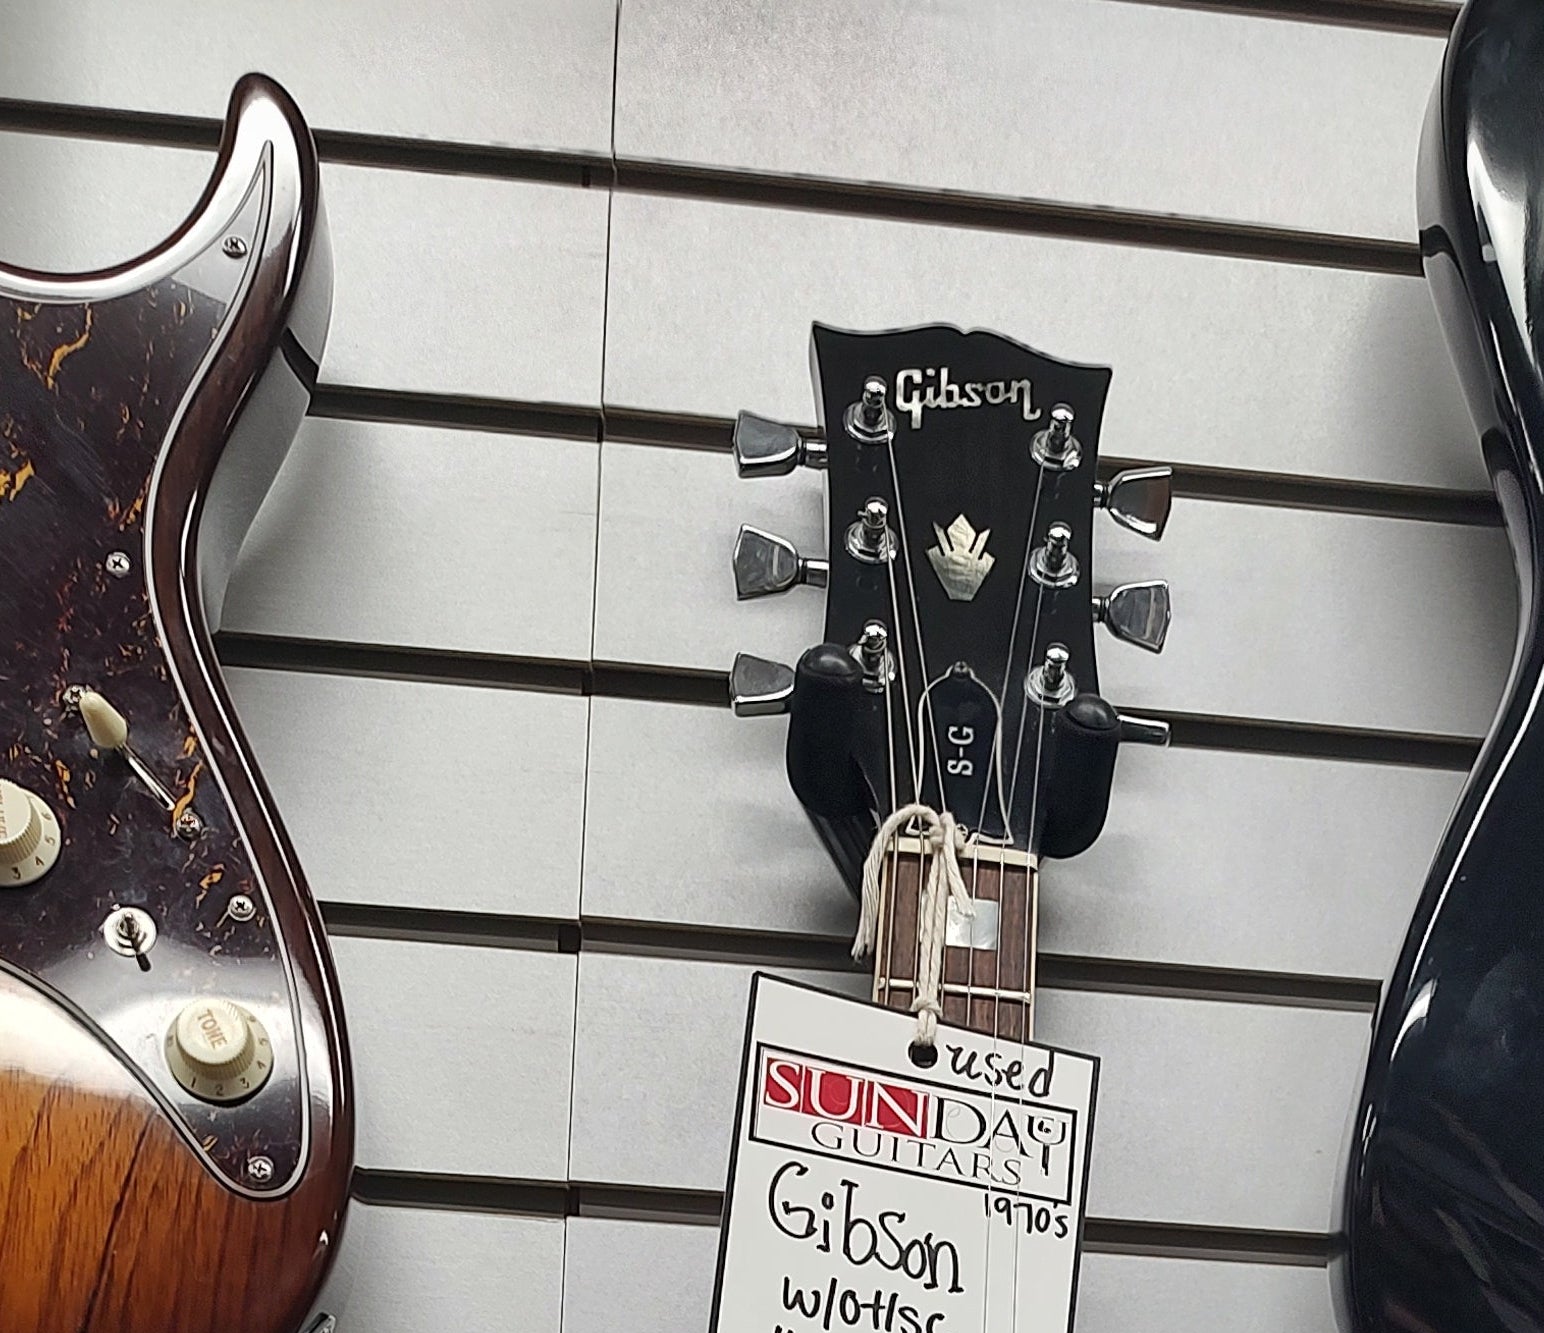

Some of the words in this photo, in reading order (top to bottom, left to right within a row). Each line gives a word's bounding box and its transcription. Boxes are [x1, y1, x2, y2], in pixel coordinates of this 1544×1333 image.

[896, 367, 1042, 428] Gibson
[197, 1008, 228, 1049] TONE
[191, 1077, 196, 1088] 1
[215, 1083, 224, 1096] 2
[946, 1043, 1055, 1098] used
[763, 1059, 1067, 1176] SUNDAY
[810, 1121, 1022, 1186] GUITARS
